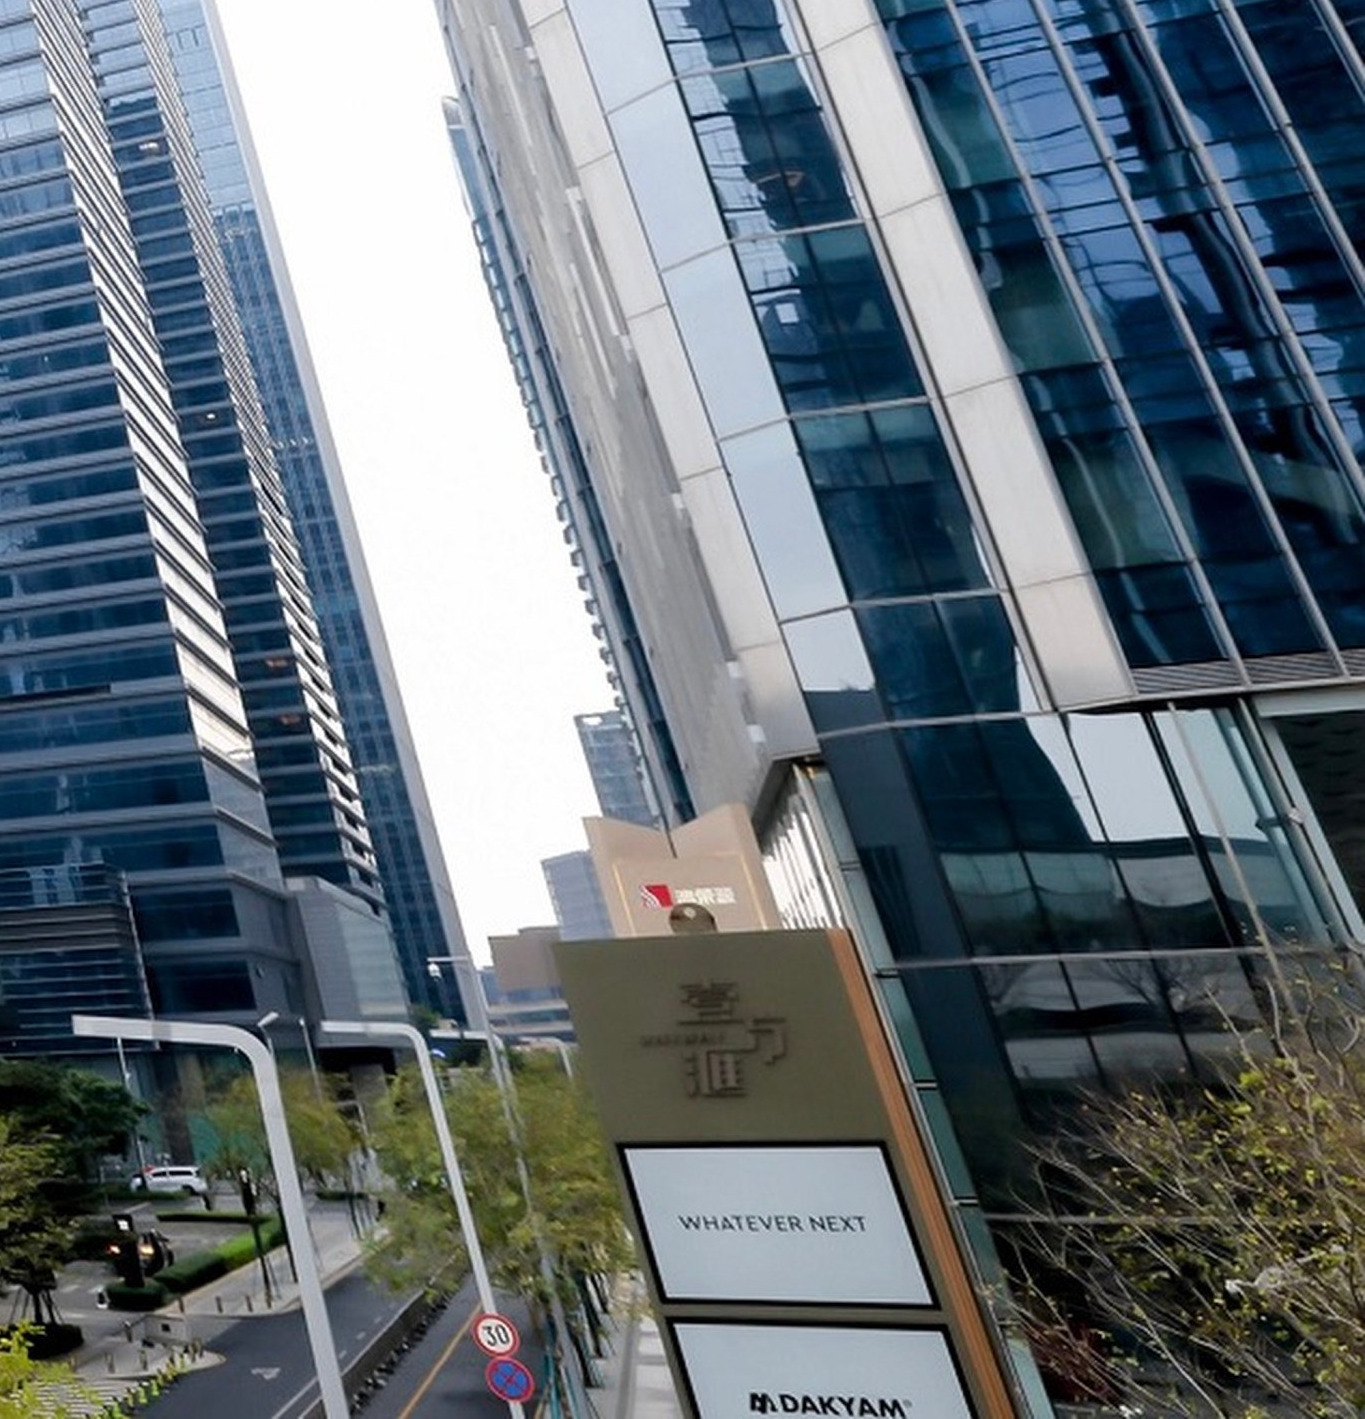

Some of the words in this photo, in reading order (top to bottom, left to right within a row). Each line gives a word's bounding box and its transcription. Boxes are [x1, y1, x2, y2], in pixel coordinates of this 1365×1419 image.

[678, 1215, 805, 1232] WHATEVER
[808, 1215, 867, 1232] NEXT
[482, 1324, 510, 1346] 30
[778, 1393, 907, 1419] DAKYAM
